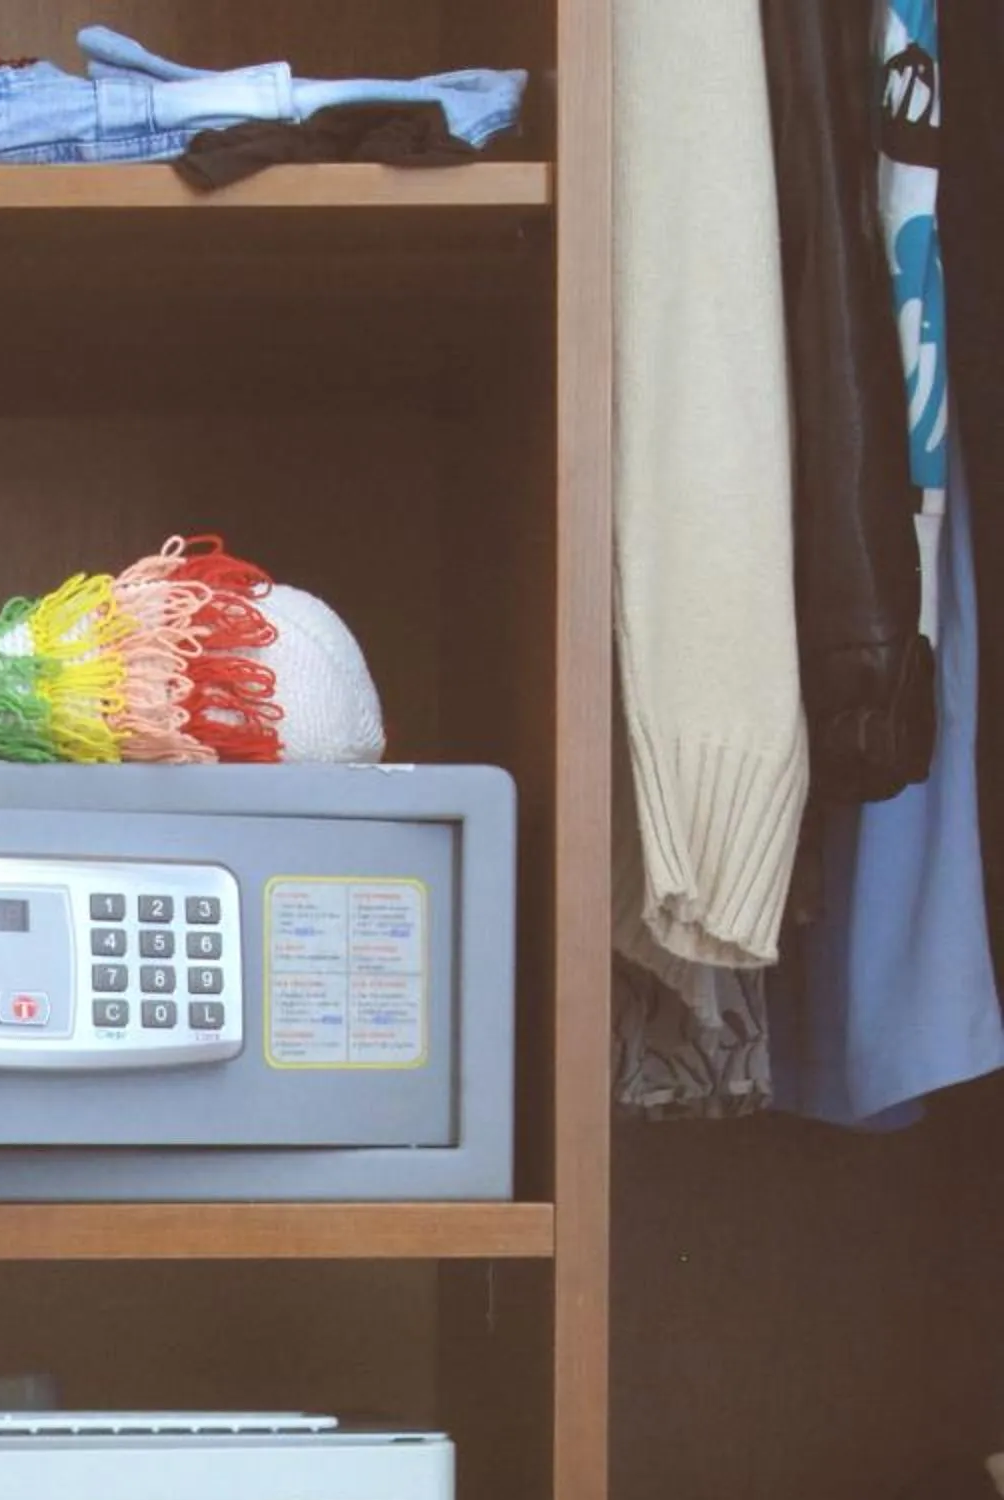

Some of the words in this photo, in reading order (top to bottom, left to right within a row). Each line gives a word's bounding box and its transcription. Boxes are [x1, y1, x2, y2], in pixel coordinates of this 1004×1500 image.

[106, 899, 113, 914] 1
[152, 901, 164, 915] 2
[199, 902, 211, 917] 3
[104, 933, 116, 949] 4
[153, 935, 165, 951] 5
[200, 937, 213, 953] 6
[107, 969, 118, 985] 7
[154, 971, 166, 987] 8
[201, 971, 213, 987] 9
[105, 1005, 121, 1021] C
[155, 1006, 167, 1022] 0
[203, 1007, 215, 1023] L
